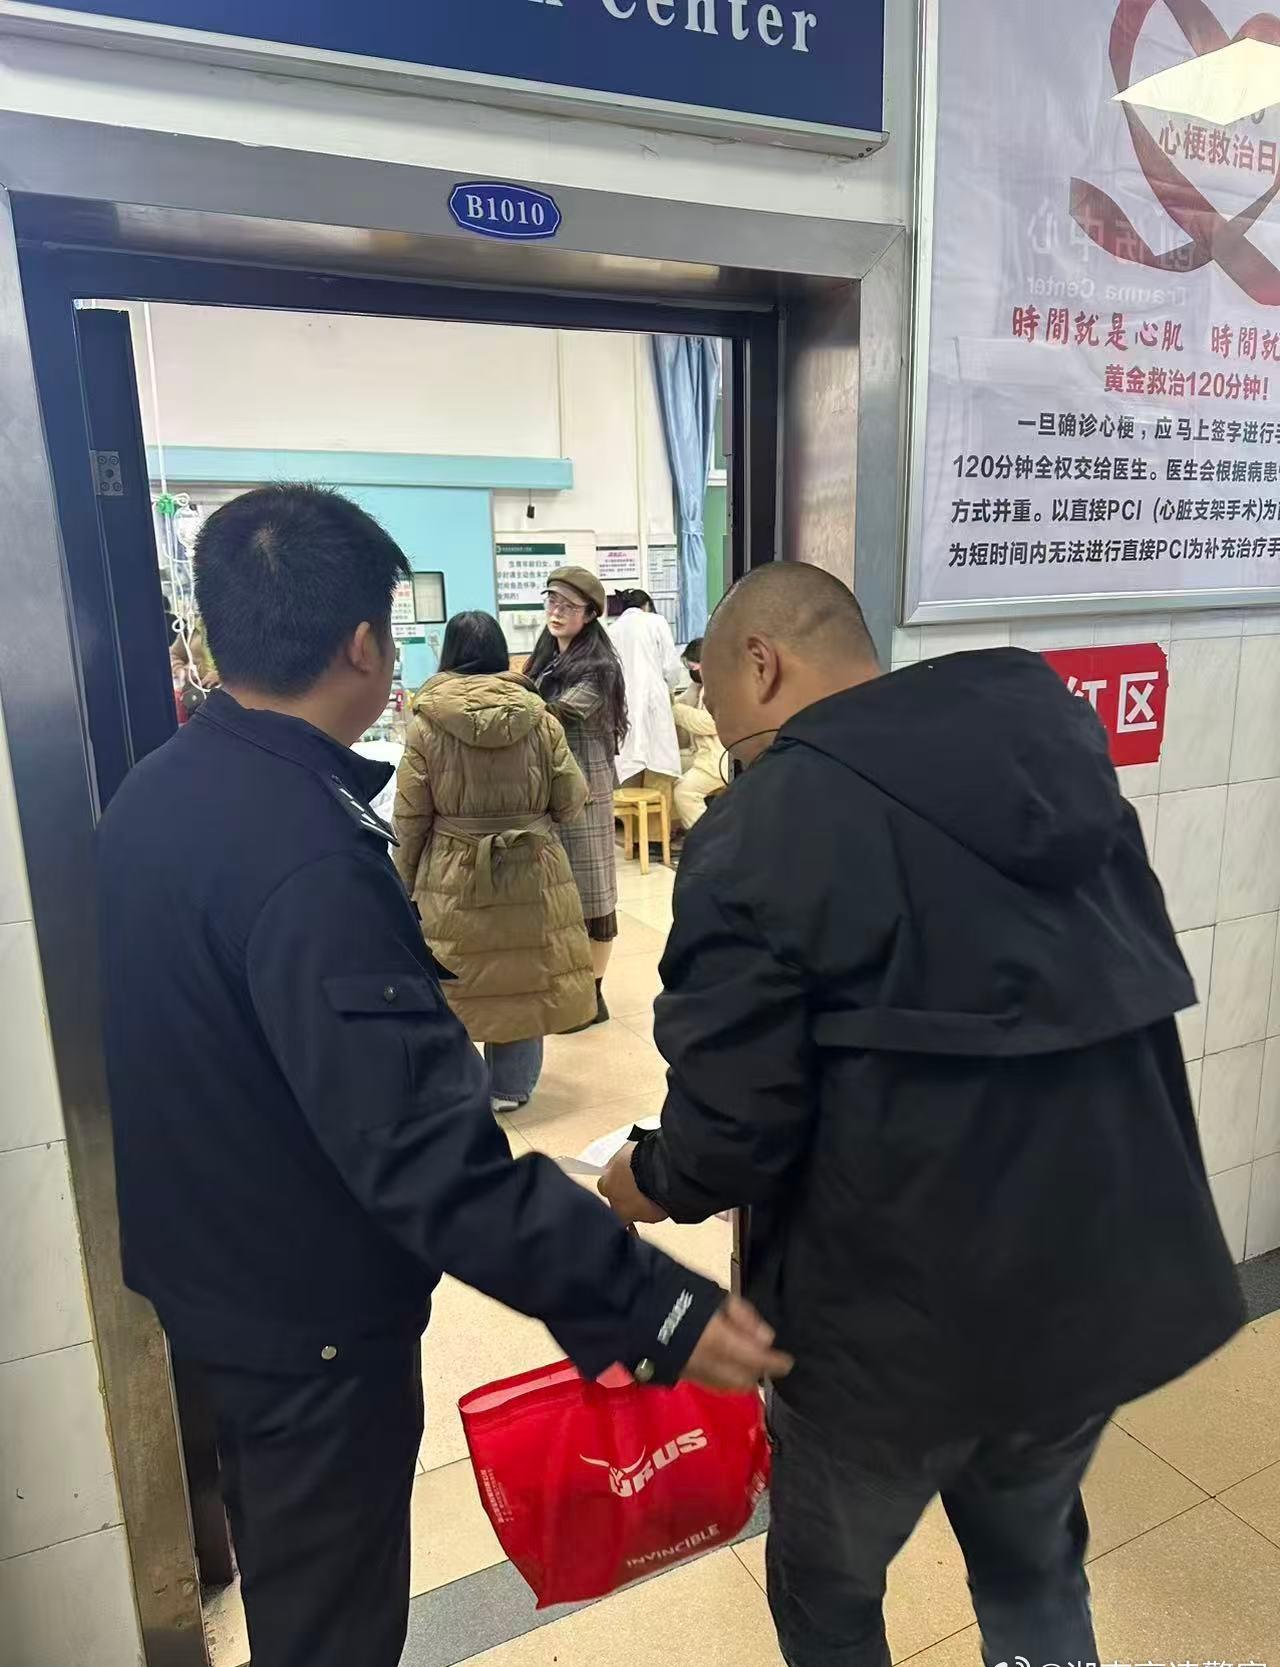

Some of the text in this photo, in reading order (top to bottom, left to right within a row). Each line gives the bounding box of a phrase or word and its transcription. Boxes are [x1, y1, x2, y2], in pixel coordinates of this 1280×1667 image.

[1158, 120, 1278, 175] 心梗救治日
[466, 194, 546, 227] B1010
[1012, 305, 1184, 352] 時間就是心肌
[1104, 364, 1269, 401] 黄金救治120分钟!
[953, 454, 1280, 483] 120分钟全权交给医生。医生会根据病患
[626, 1523, 720, 1568] INVINCIBLE
